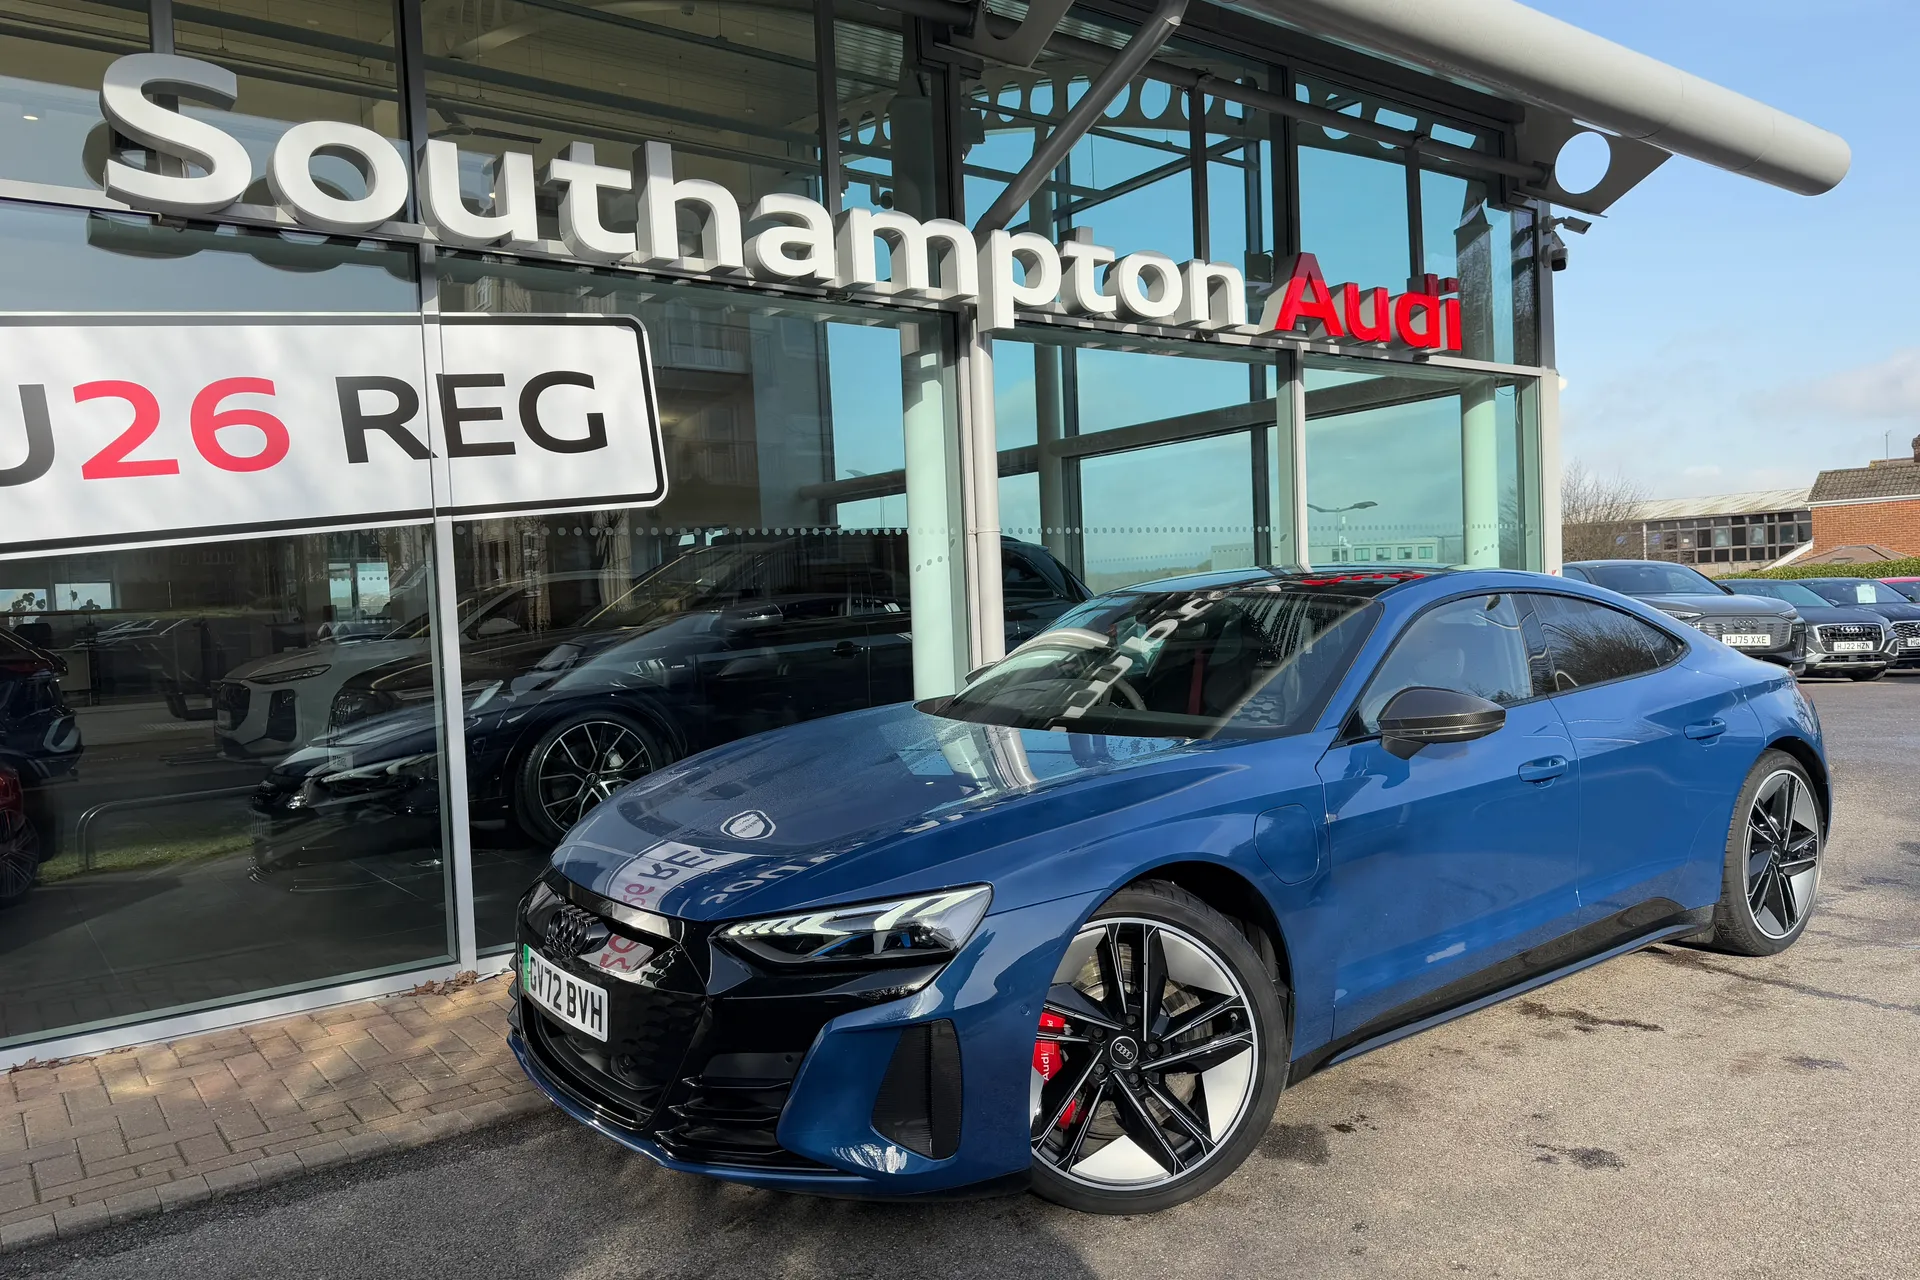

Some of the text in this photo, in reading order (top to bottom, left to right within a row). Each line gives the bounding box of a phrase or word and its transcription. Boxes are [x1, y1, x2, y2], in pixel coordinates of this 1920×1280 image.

[99, 52, 1462, 352] Southampton Audi
[335, 370, 609, 464] REG
[1725, 635, 1767, 644] HJ75 XXE
[1836, 642, 1855, 650] HJ22
[530, 956, 602, 1033] GV72 BVH
[1041, 1053, 1050, 1081] Audi
